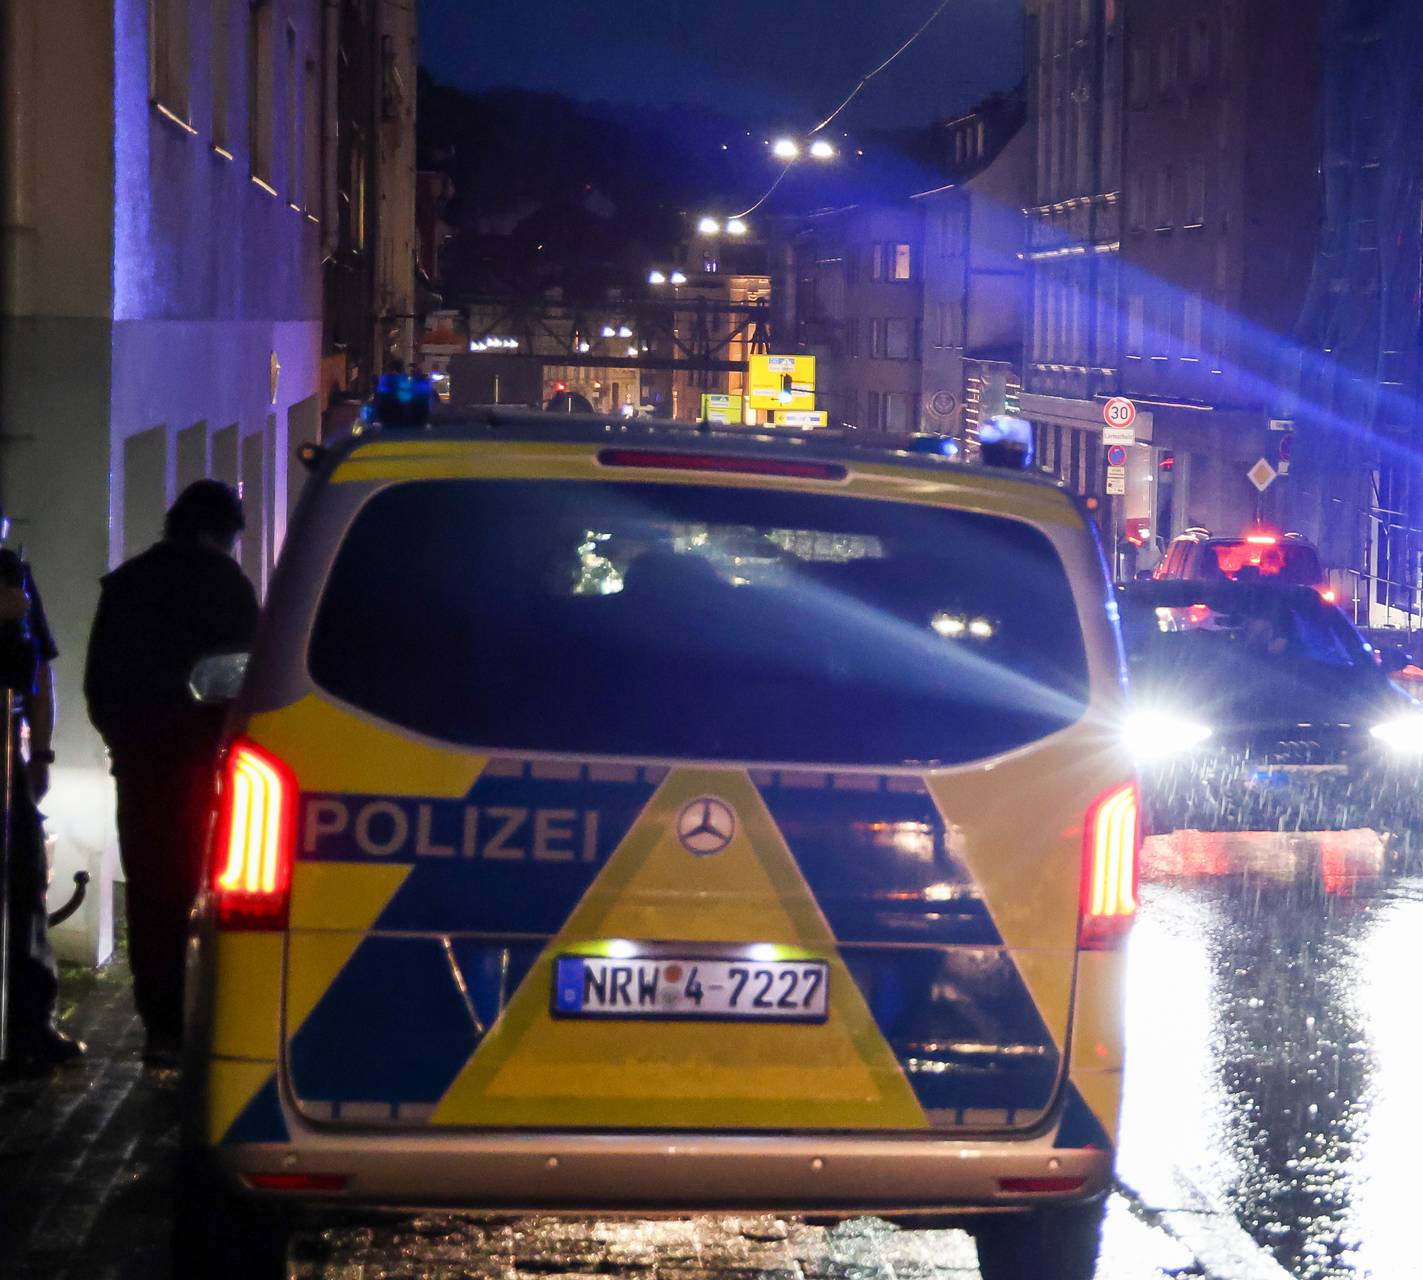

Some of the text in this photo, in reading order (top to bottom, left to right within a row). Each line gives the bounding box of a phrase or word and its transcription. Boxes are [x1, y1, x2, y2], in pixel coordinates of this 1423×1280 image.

[1111, 406, 1128, 420] 30
[303, 800, 599, 862] POLIZEI
[584, 964, 660, 1006] NRW
[683, 965, 823, 1009] 4-7227
